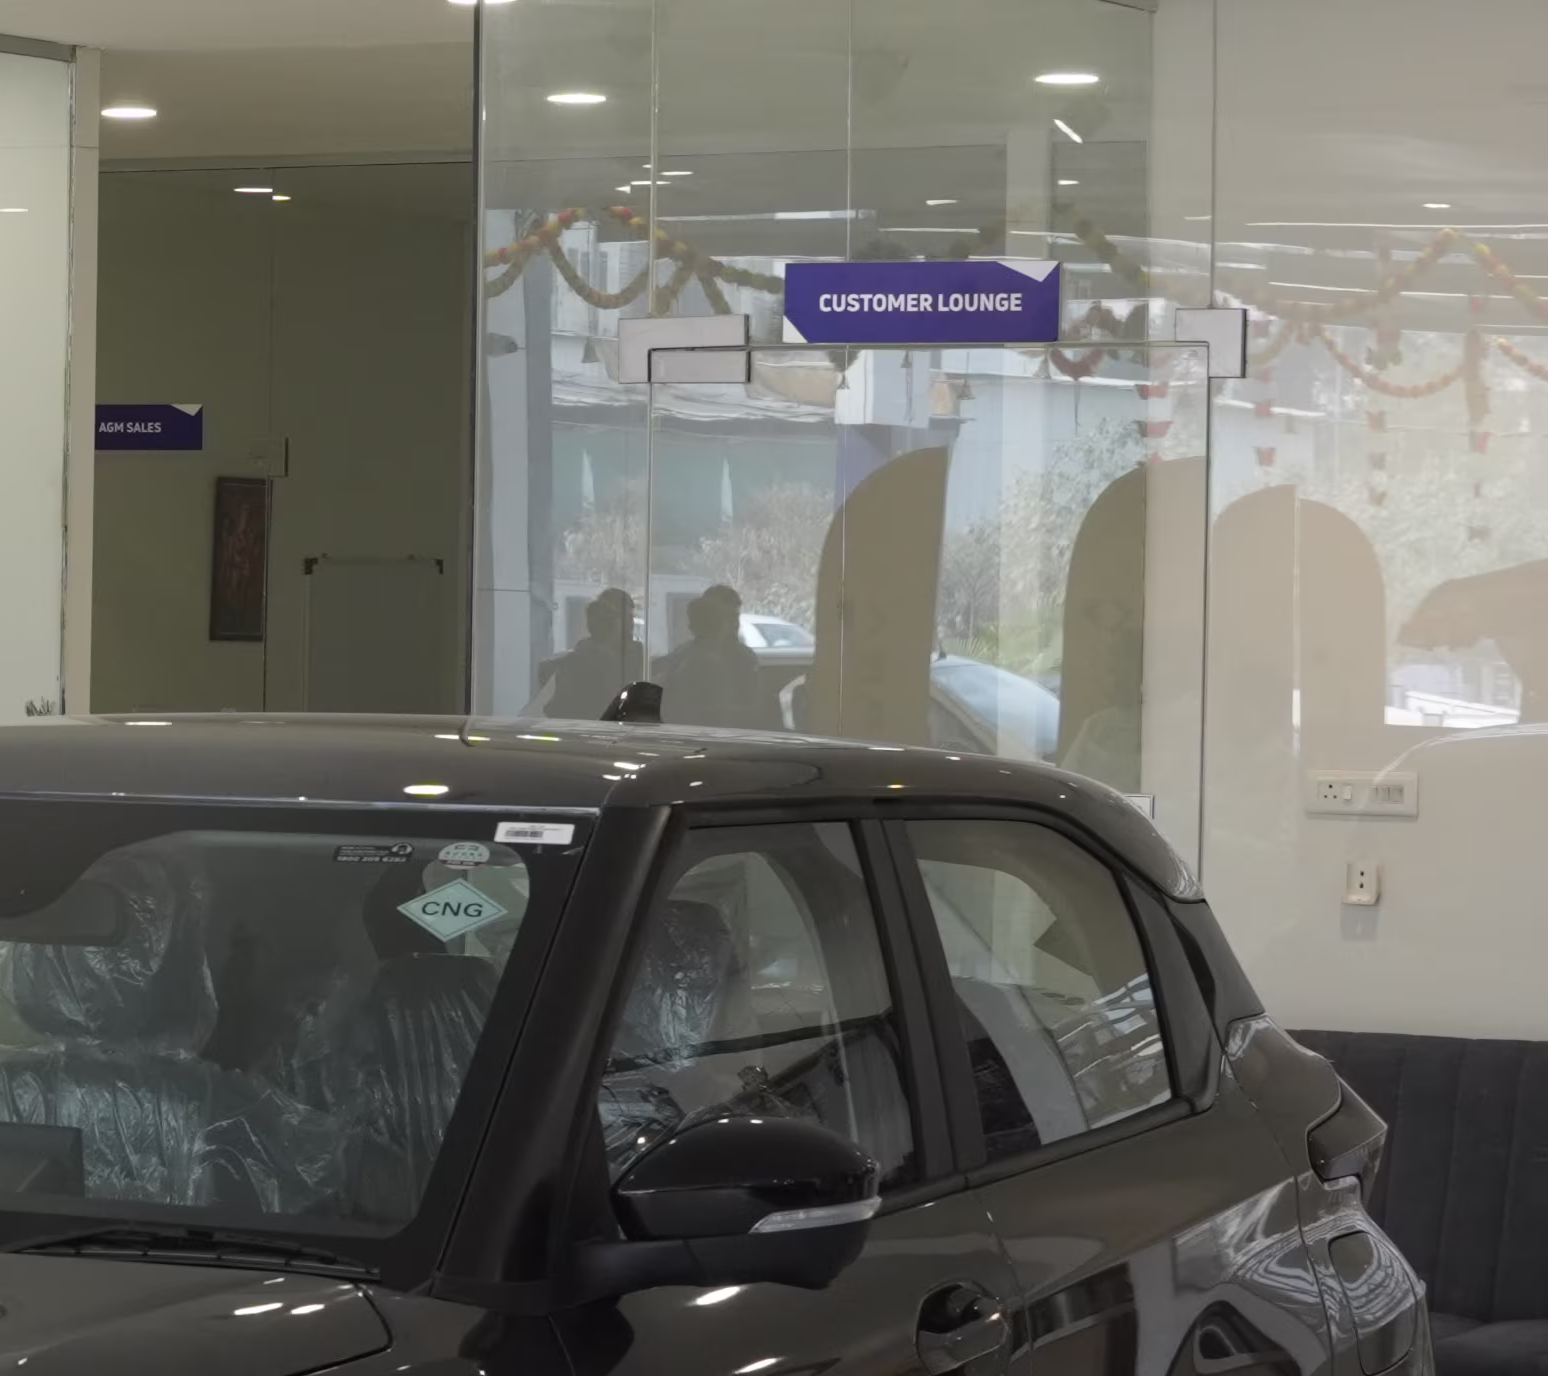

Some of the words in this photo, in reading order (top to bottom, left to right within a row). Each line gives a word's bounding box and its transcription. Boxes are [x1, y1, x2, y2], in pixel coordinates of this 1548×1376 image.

[818, 292, 932, 314] CUSTOMER
[938, 292, 1023, 314] LOUNGE
[98, 422, 124, 433] AGM
[126, 422, 162, 433] SALES
[421, 901, 483, 919] CNG
